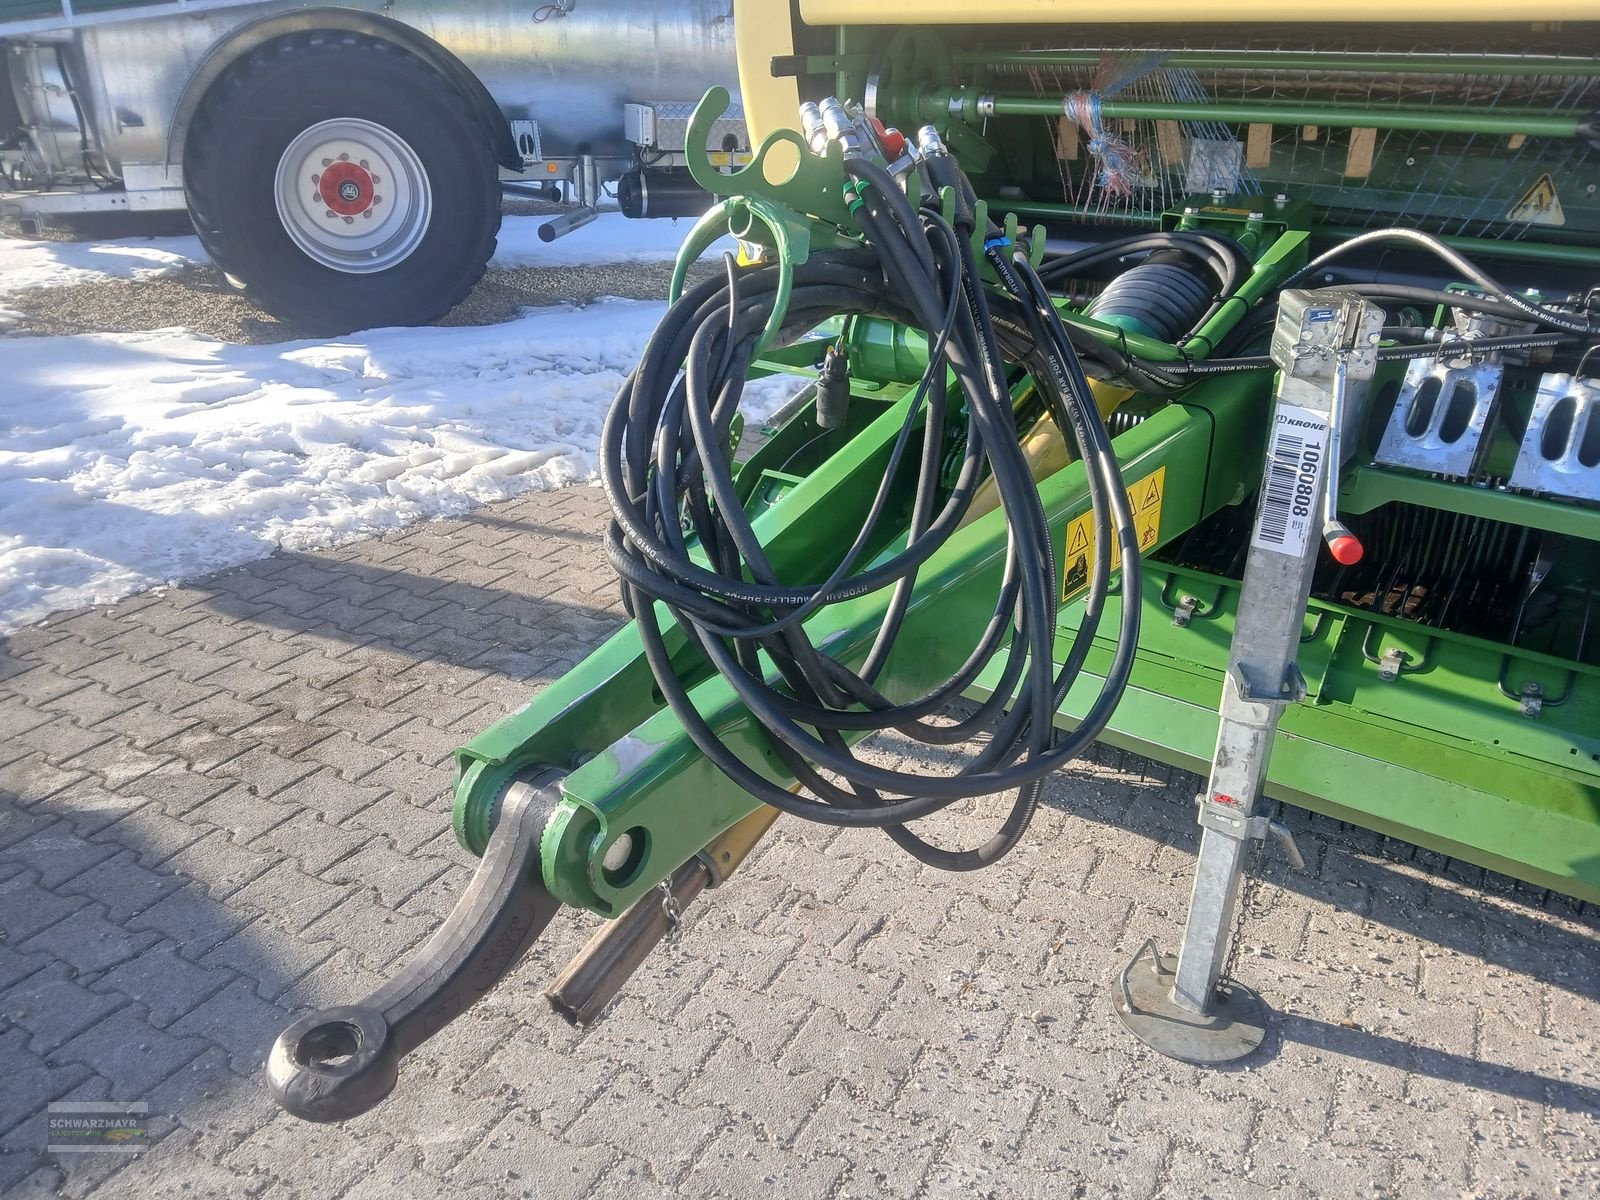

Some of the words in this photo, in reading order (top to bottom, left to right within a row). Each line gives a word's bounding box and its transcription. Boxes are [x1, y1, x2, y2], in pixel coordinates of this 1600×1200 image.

[993, 254, 1020, 294] HYDRAULIK
[1504, 293, 1540, 317] HYDRAULIK
[1539, 311, 1570, 329] MUELLER
[1491, 343, 1521, 351] MUELLER
[1287, 418, 1327, 431] KRONE
[1292, 441, 1321, 517] 1060808
[612, 504, 622, 519] WP
[638, 537, 657, 558] DN10
